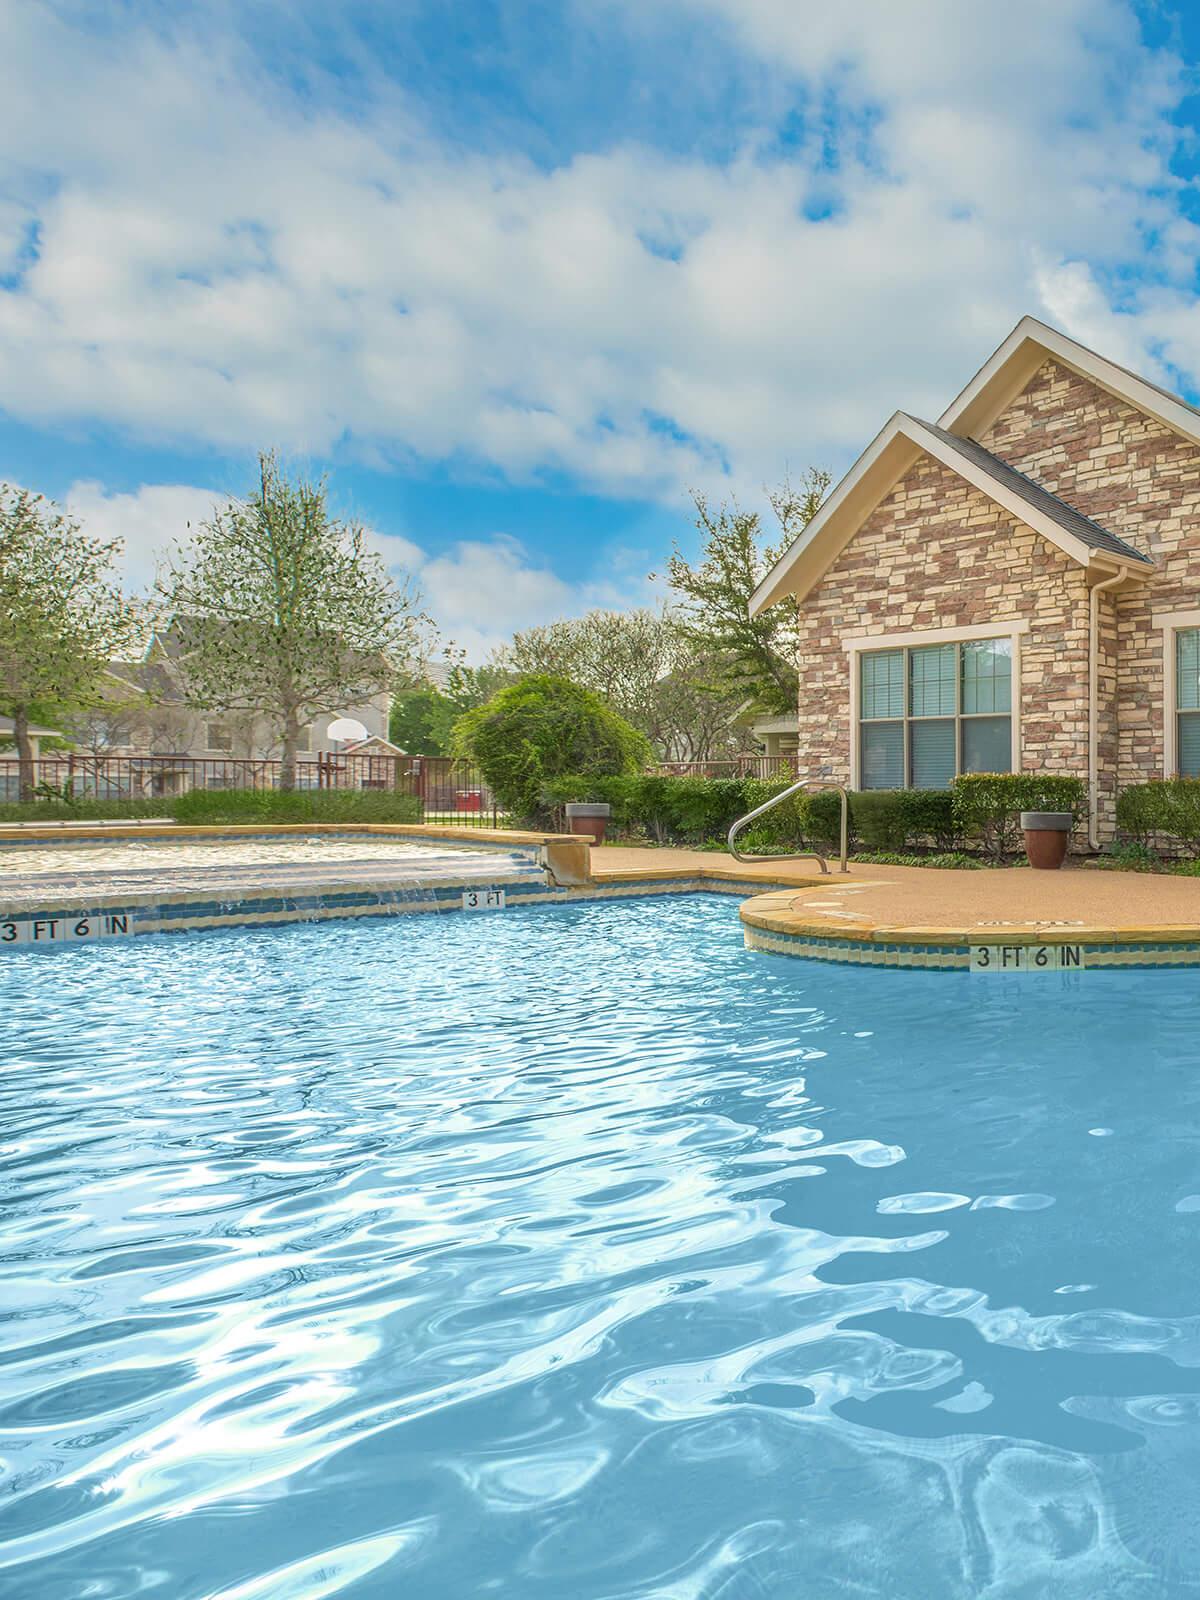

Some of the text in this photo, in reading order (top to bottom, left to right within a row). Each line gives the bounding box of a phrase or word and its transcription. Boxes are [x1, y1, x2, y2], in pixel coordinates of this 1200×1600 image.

[468, 891, 502, 907] 3 FT
[1, 915, 129, 941] 3 FT 6 IN
[977, 946, 1080, 967] 3 FT 6 IN
